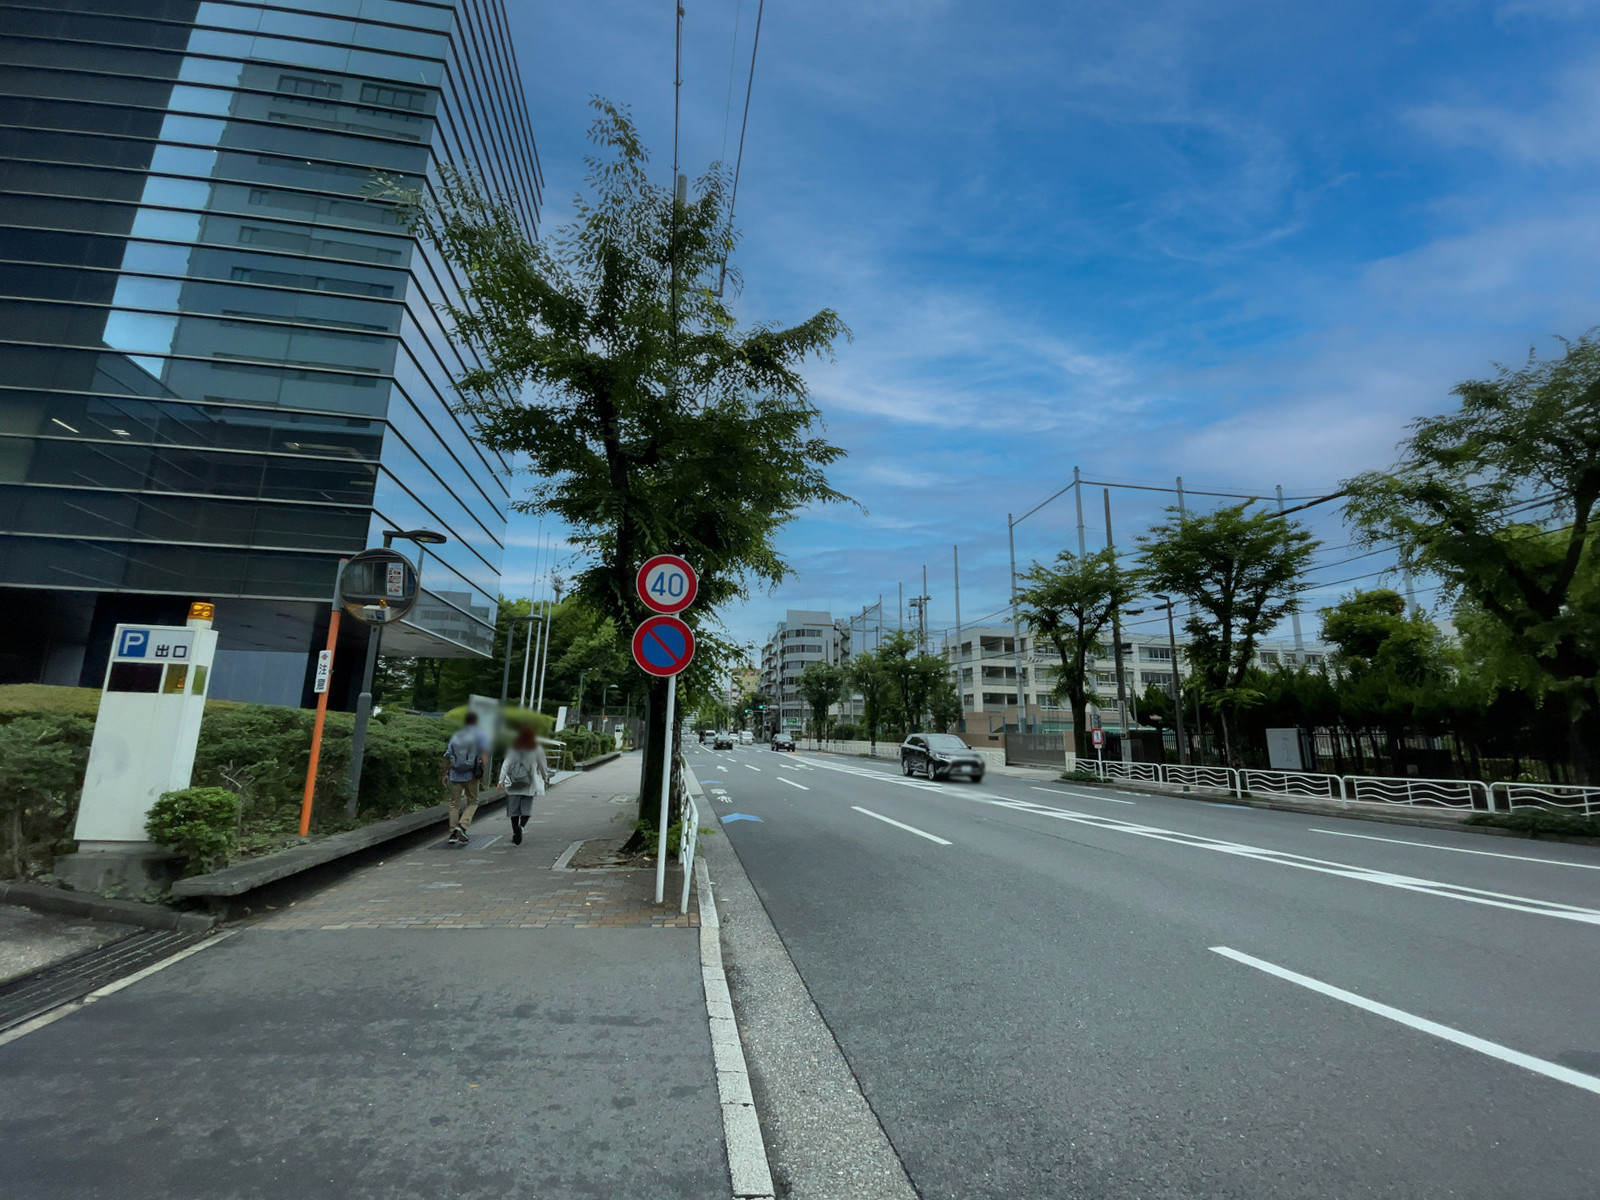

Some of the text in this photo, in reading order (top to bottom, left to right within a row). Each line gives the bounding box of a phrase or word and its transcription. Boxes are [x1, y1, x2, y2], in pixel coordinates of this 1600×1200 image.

[651, 571, 684, 597] 40
[122, 632, 188, 658] P 出口
